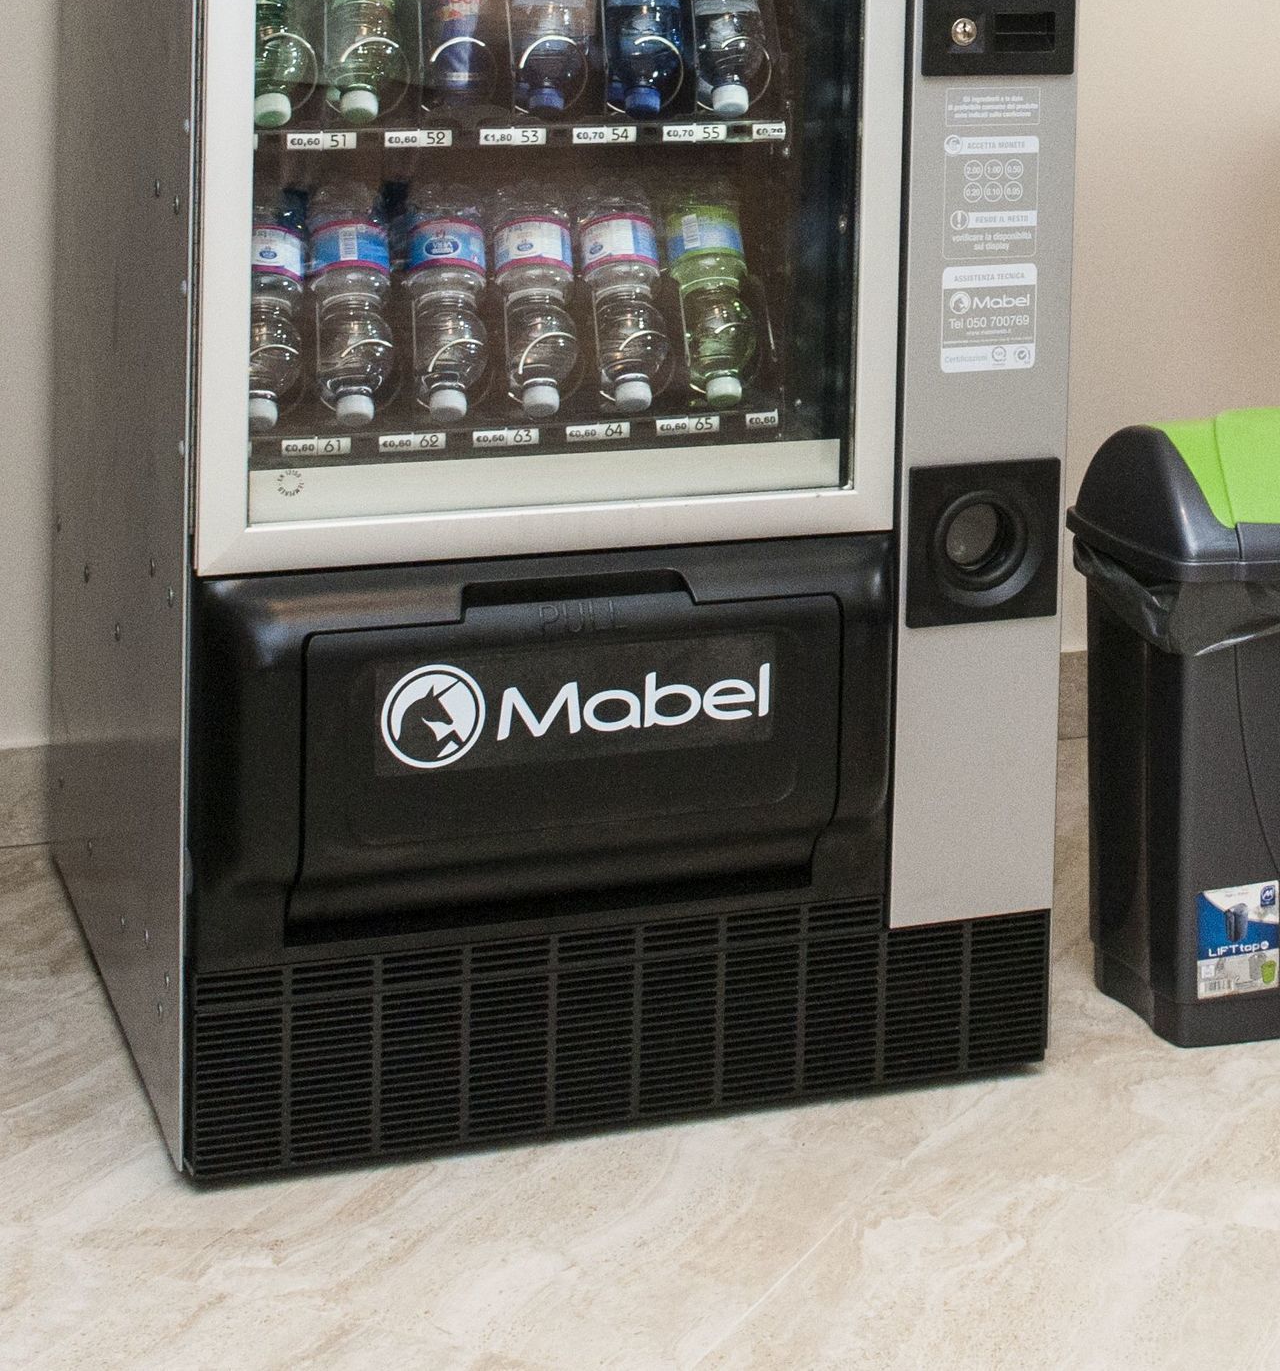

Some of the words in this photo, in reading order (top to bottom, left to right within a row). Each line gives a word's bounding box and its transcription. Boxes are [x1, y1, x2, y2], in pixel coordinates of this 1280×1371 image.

[426, 131, 445, 145] 52
[520, 130, 540, 144] 53
[575, 130, 605, 141] €0,70
[610, 128, 630, 141] 54
[702, 125, 721, 139] 55
[329, 134, 347, 148] 51
[973, 293, 1031, 310] Mabel
[948, 318, 964, 329] Tel
[966, 317, 987, 328] 050
[989, 315, 1030, 326] 700769
[604, 424, 624, 437] 64
[694, 417, 714, 431] 65
[419, 434, 440, 448] 62
[513, 429, 533, 443] 63
[323, 439, 343, 453] 61
[537, 598, 628, 635] PULL
[496, 662, 771, 742] Mabel
